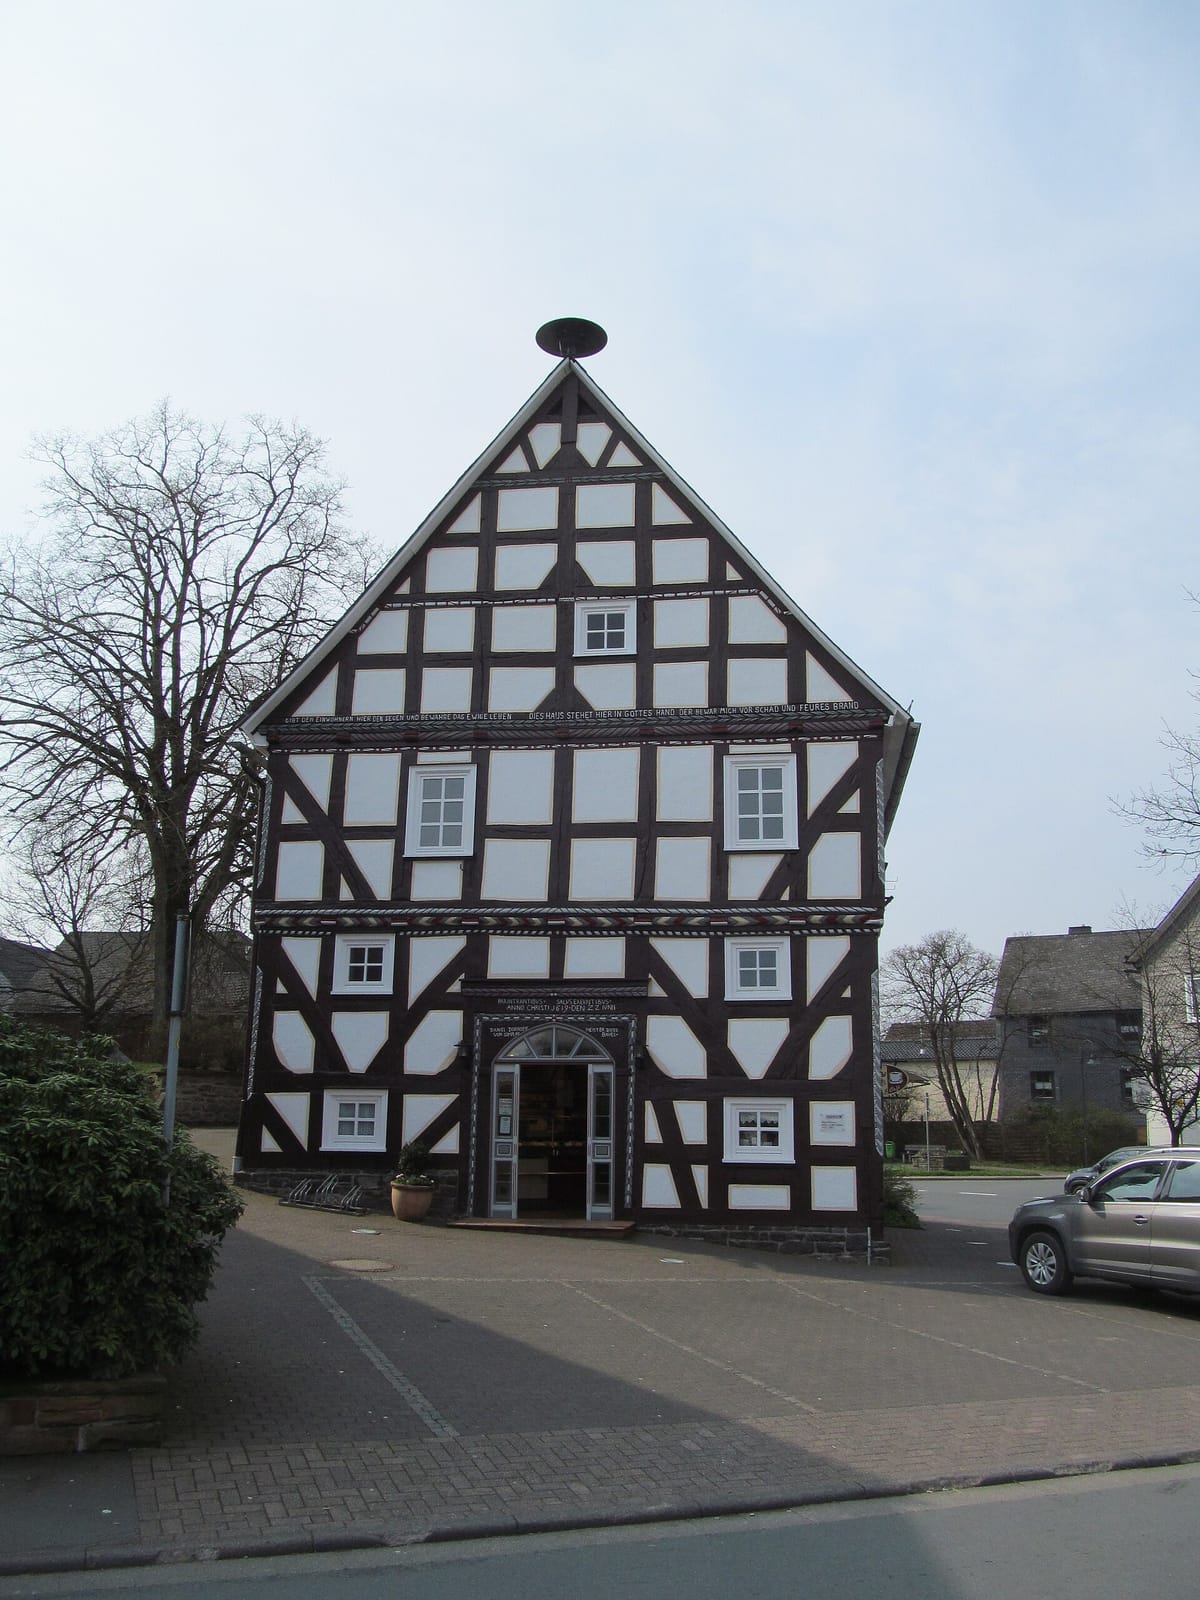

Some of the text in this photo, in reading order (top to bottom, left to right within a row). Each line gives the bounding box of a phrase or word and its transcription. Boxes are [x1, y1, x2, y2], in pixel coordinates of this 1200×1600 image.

[529, 712, 545, 720] DIES
[545, 712, 565, 720] HAUS
[566, 711, 593, 719] STEHET
[614, 710, 622, 718] IN
[624, 709, 653, 718] GOTTES
[656, 708, 675, 716] HAND
[680, 708, 693, 716] DER
[720, 707, 737, 715] MICH
[739, 706, 753, 714] VOR
[754, 705, 779, 714] SCHAD
[782, 704, 796, 712] UND
[800, 703, 830, 712] FEURES
[833, 701, 859, 710] BRAND
[526, 1004, 550, 1012] CHRISTI
[571, 1004, 586, 1012] DEN
